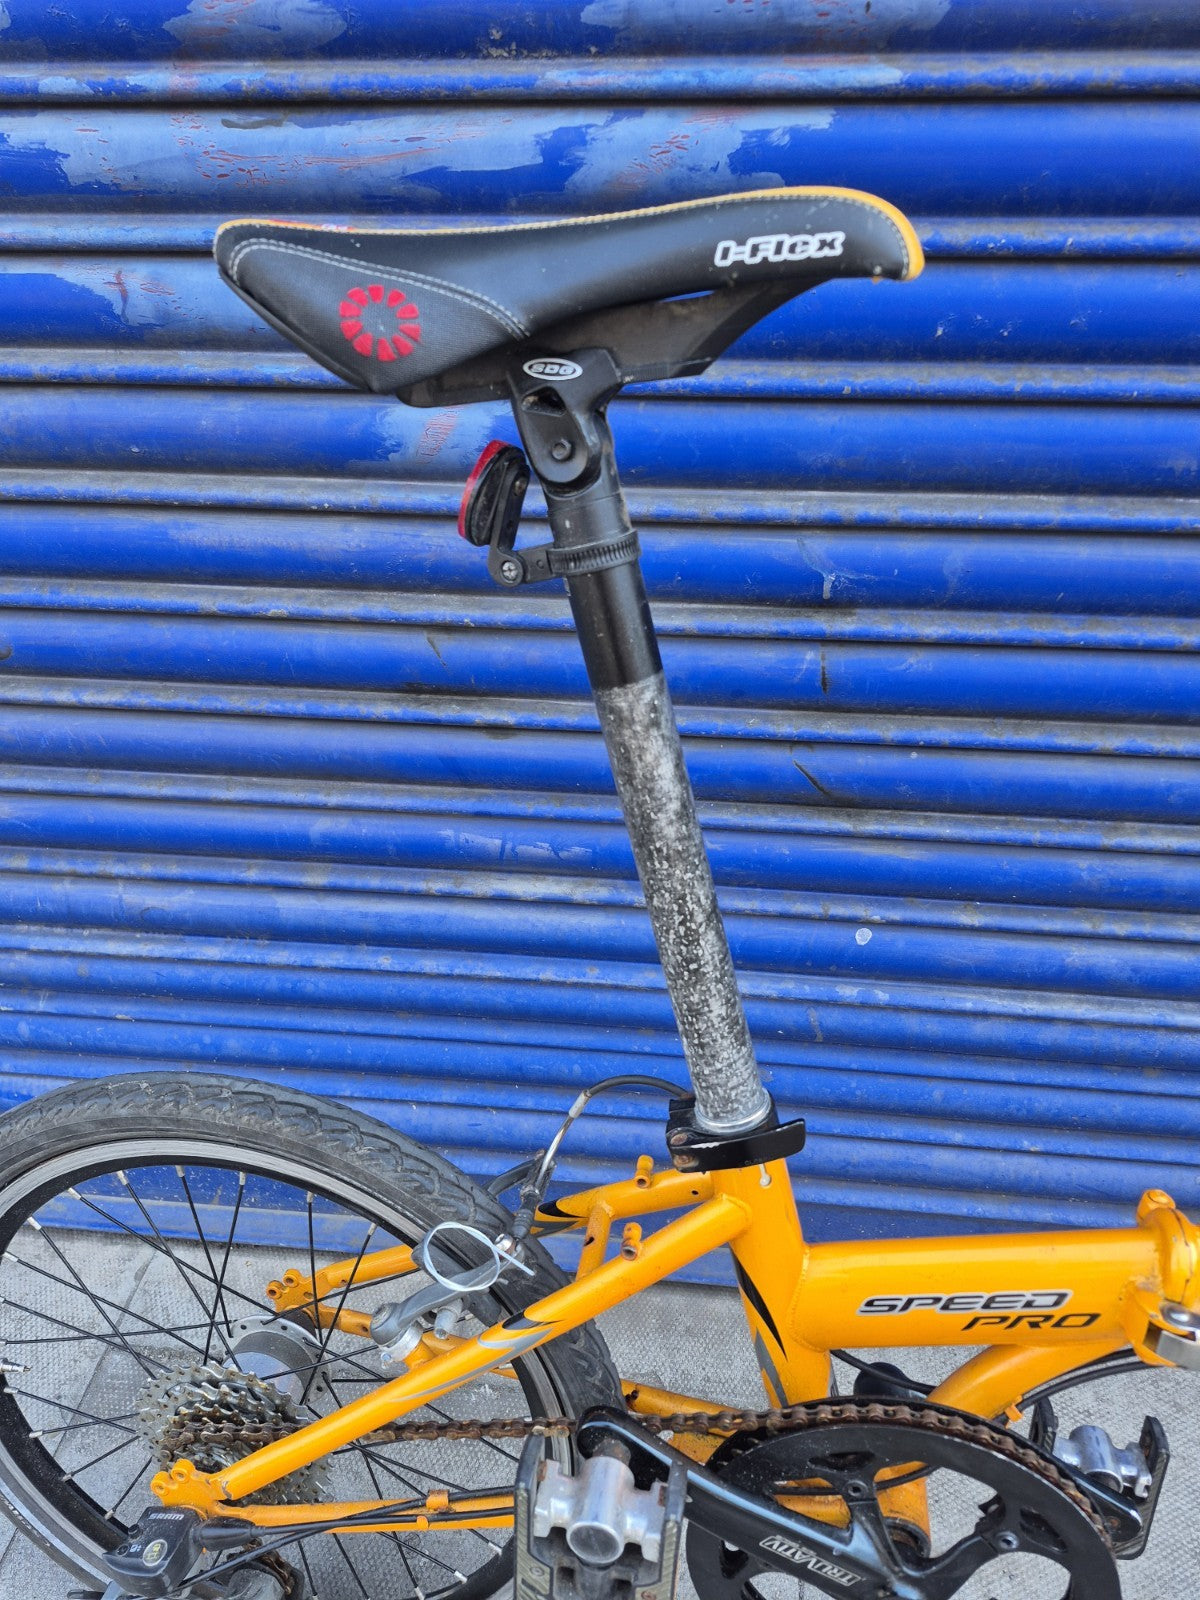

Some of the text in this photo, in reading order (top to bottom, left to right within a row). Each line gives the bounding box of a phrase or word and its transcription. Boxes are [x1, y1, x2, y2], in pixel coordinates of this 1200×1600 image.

[856, 1289, 1074, 1316] SPEED
[960, 1312, 1102, 1331] PRO
[148, 1512, 185, 1521] SRAM
[760, 1536, 861, 1586] TRUVATIV
